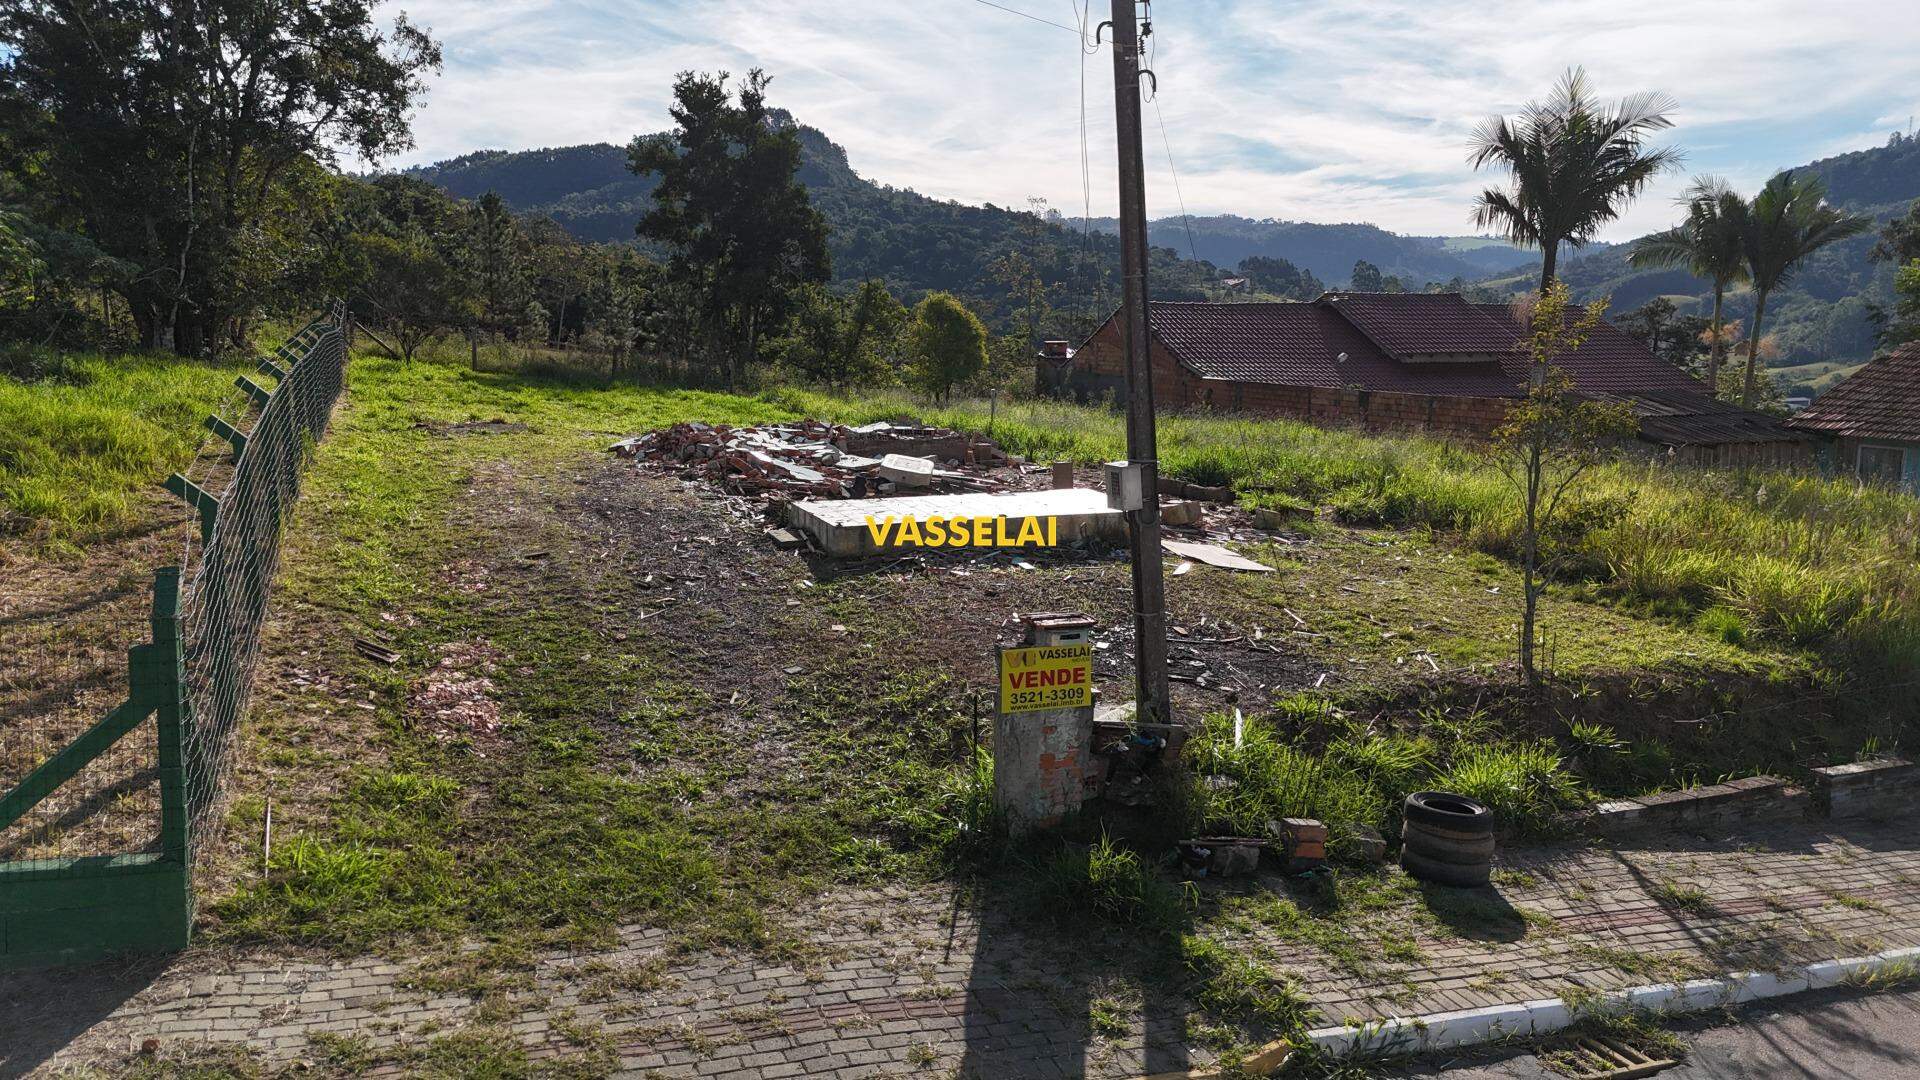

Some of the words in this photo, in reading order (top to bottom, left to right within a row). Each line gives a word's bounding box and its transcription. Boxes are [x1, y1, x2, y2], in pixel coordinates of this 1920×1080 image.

[1039, 647, 1090, 659] VASSELAI
[1009, 667, 1085, 689] VENDE
[1010, 687, 1084, 704] 3521-3309
